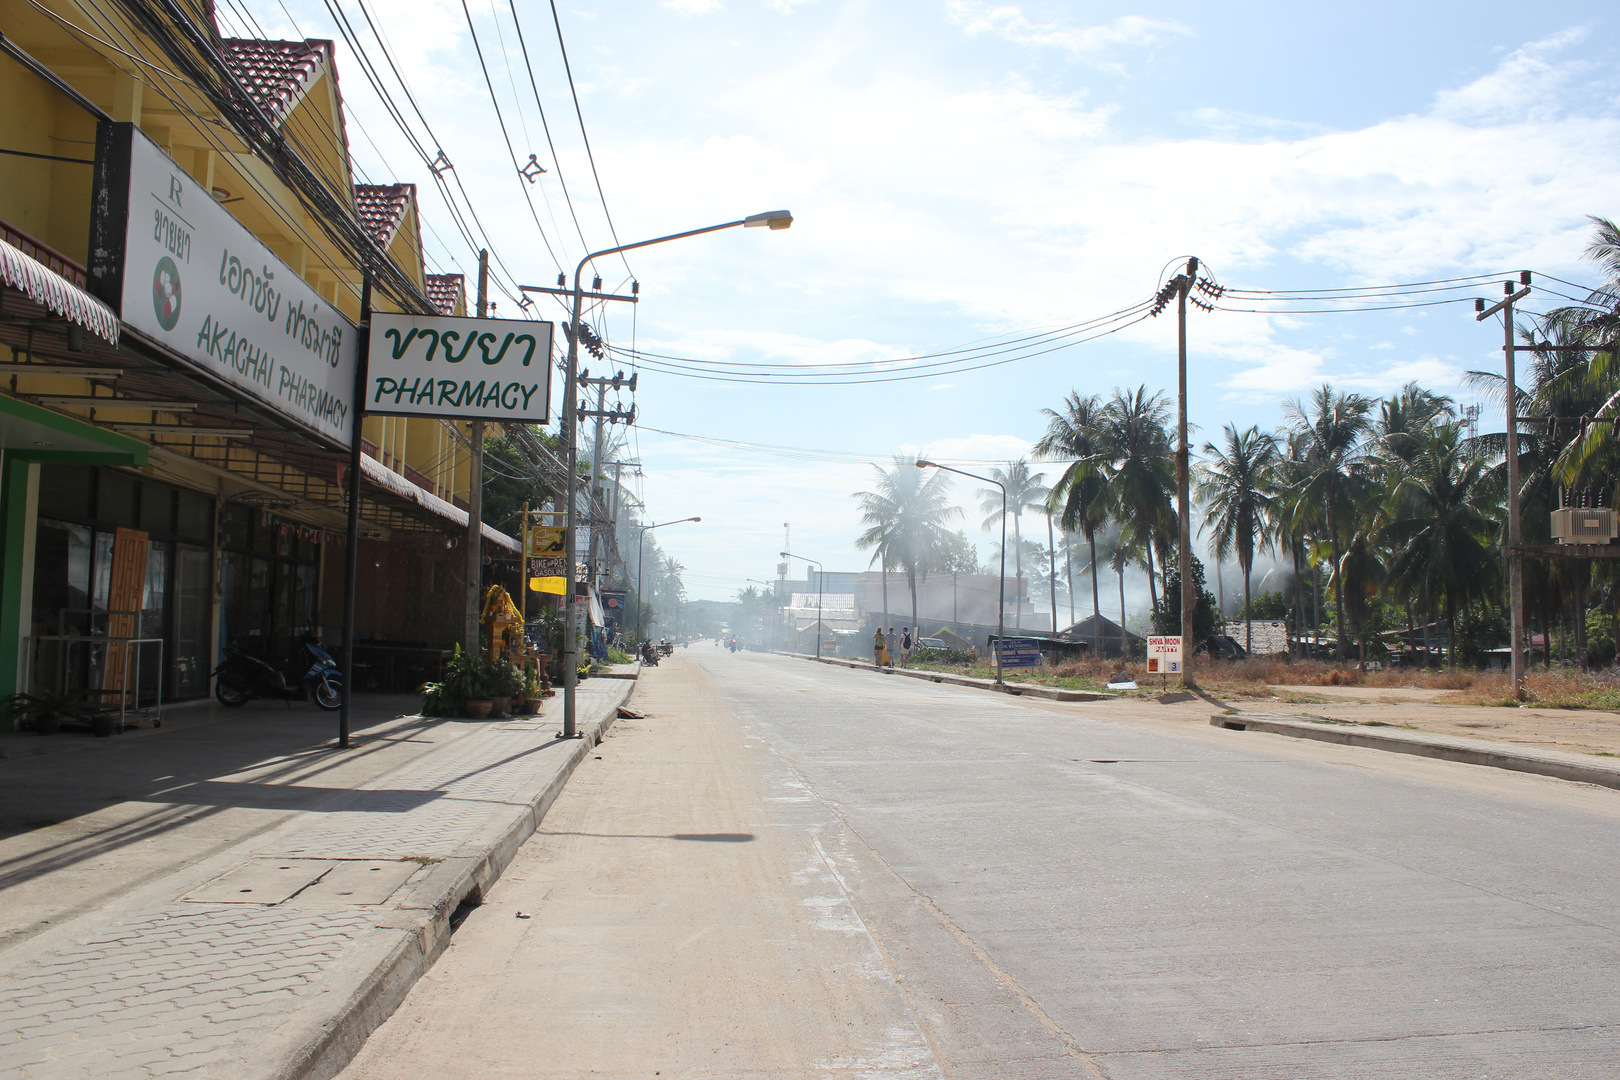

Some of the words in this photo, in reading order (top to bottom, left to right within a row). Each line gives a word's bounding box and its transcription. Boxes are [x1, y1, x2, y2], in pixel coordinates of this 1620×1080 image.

[154, 208, 191, 264] ขายยา
[219, 248, 281, 323] เอกชัย
[384, 327, 537, 367] ขายยา
[197, 314, 275, 389] AKACHAI
[278, 365, 348, 431] PHARMACY
[374, 377, 539, 410] PHARMACY
[531, 559, 548, 569] BIKE
[554, 558, 567, 569] REN
[534, 568, 567, 577] GASOLINE
